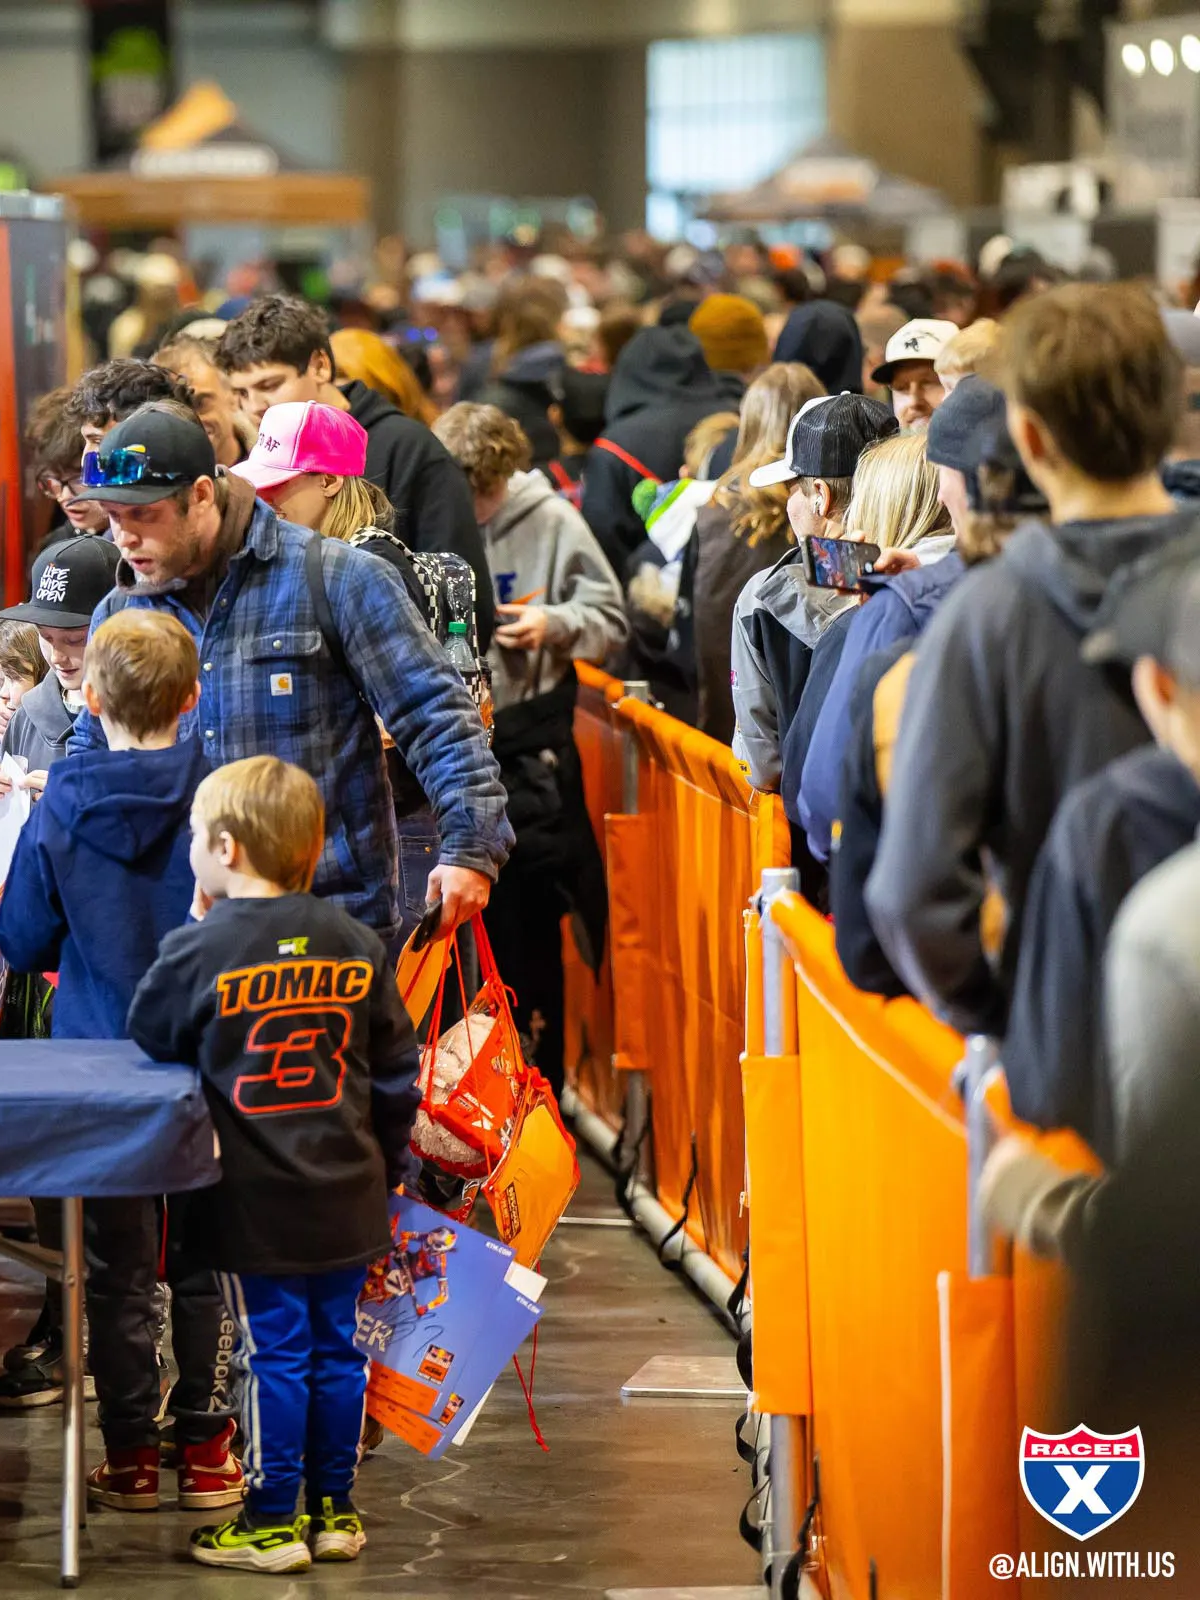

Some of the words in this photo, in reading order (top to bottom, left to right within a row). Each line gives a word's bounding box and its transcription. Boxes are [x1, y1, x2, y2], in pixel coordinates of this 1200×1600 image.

[42, 565, 70, 580] LIFE
[39, 577, 68, 592] WIDE
[36, 588, 66, 603] OPEN
[216, 958, 375, 1018] TOMAC
[231, 1004, 353, 1116] 3
